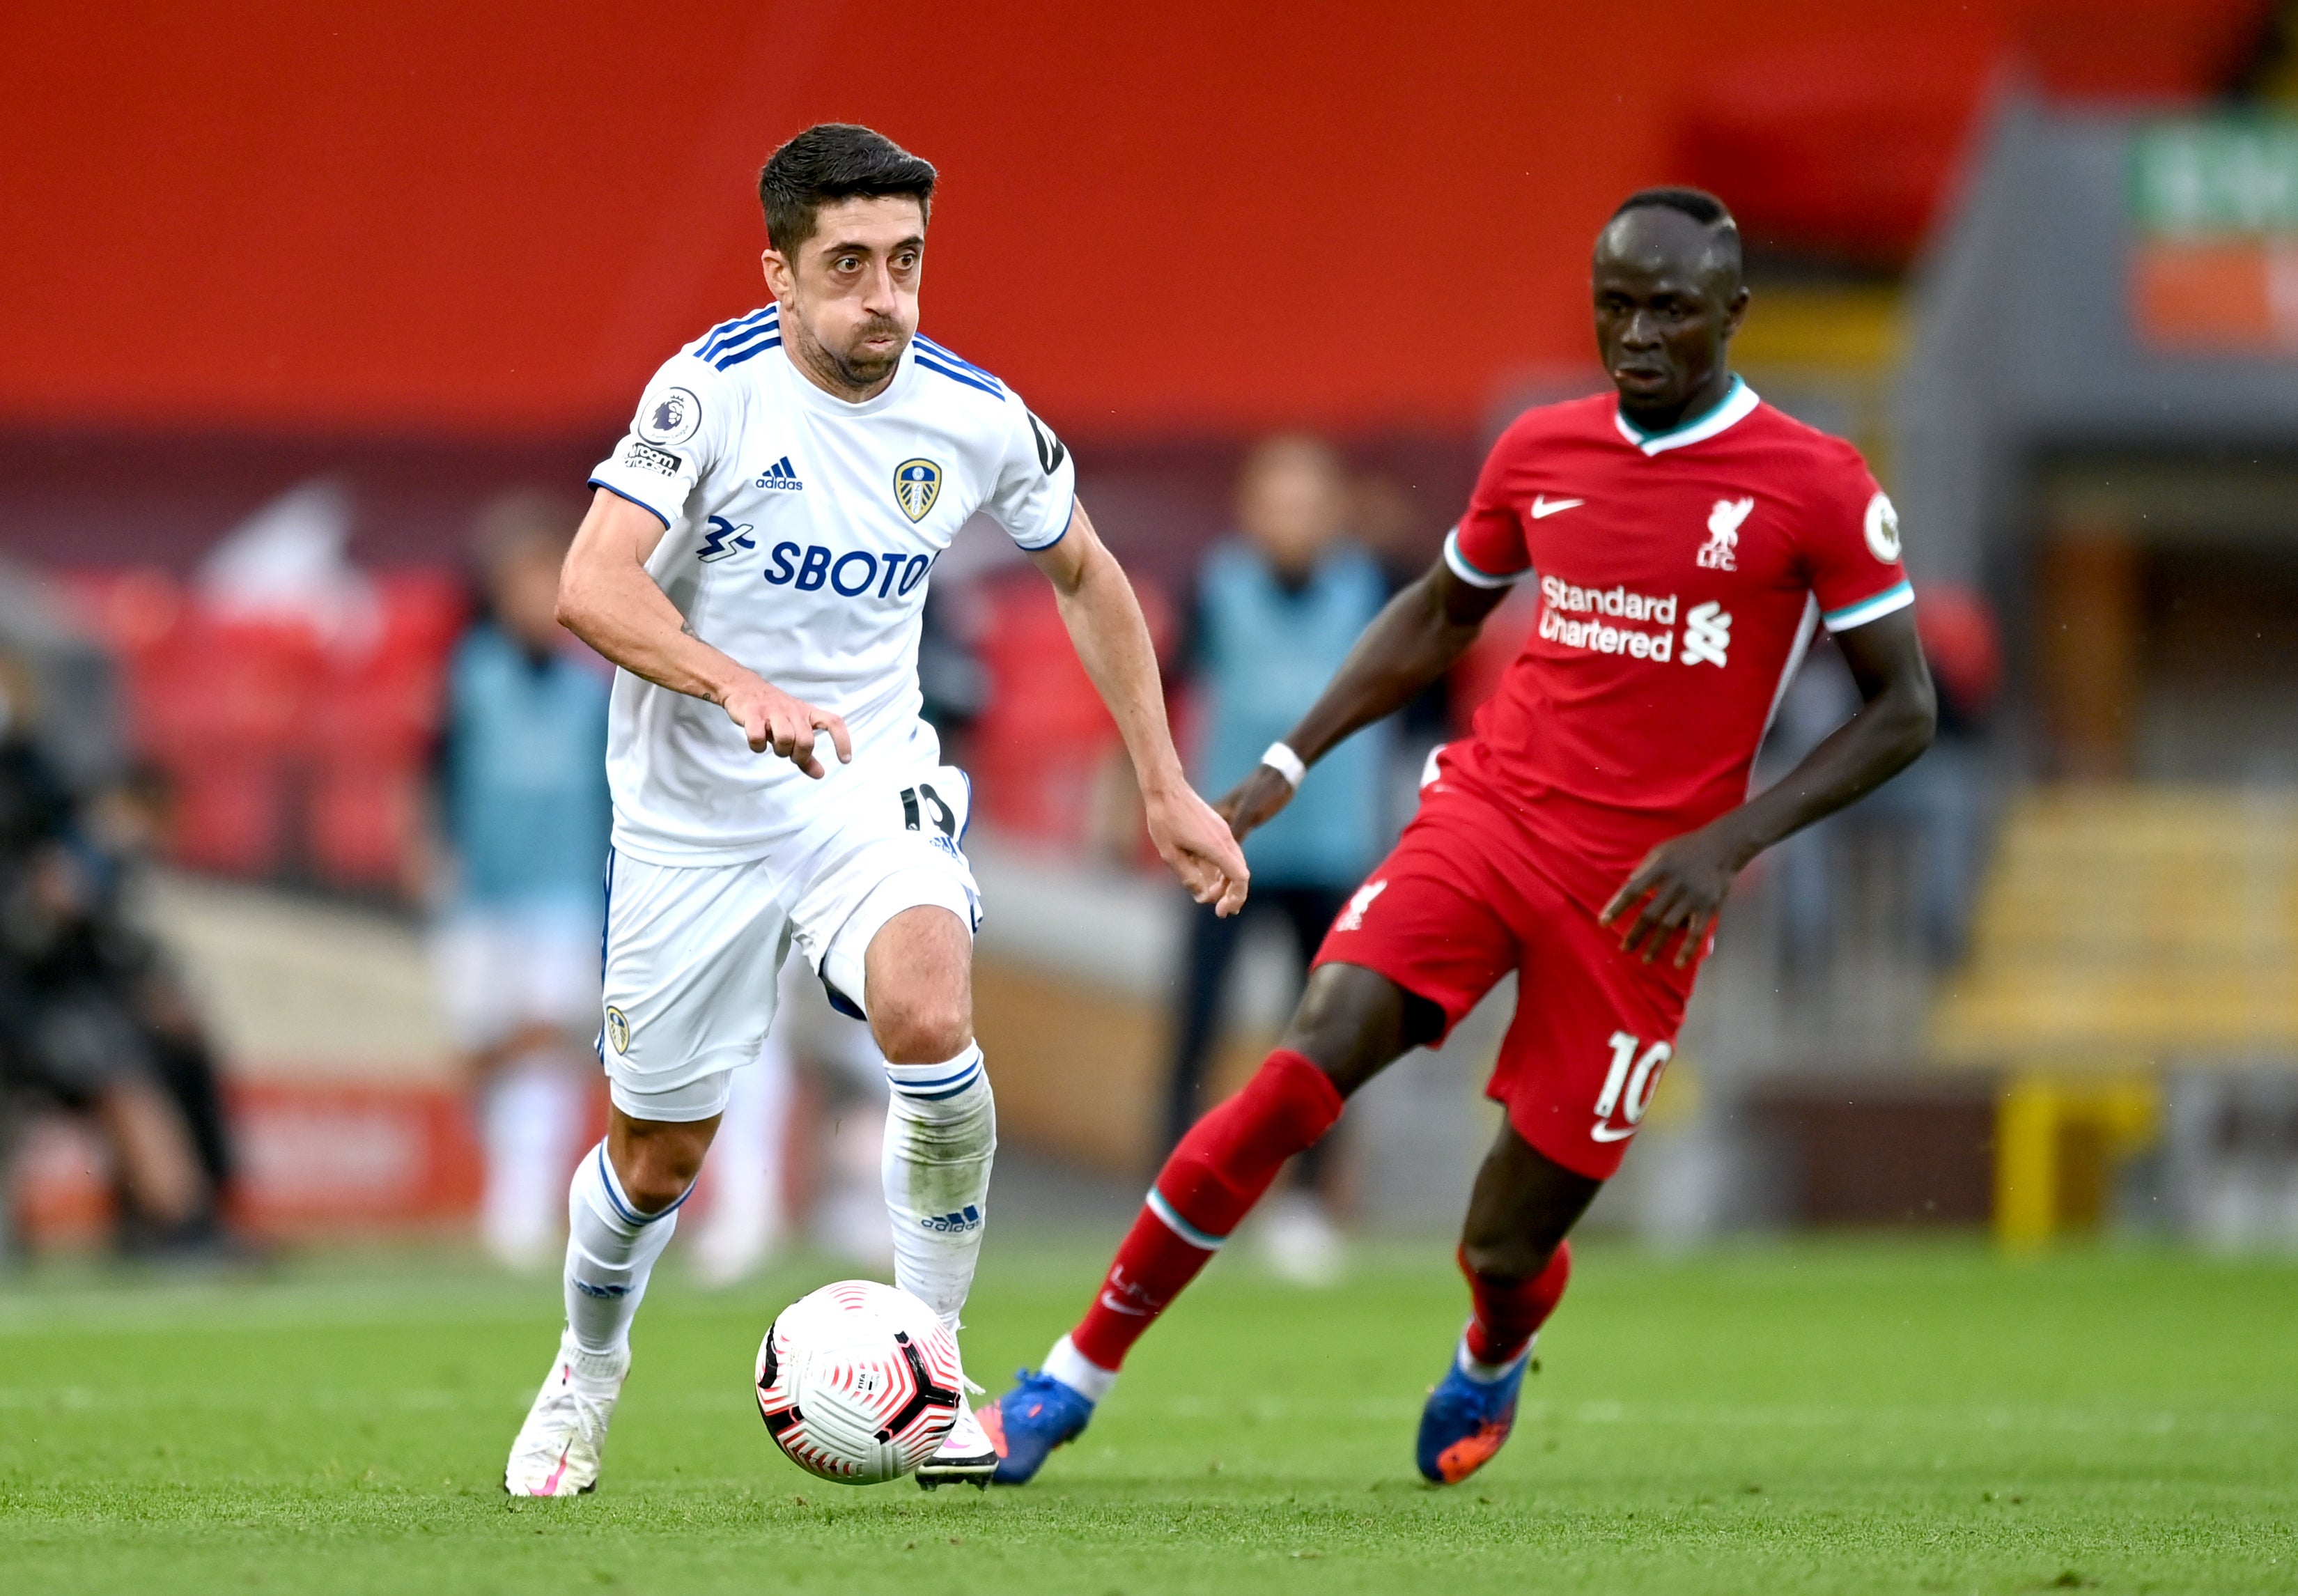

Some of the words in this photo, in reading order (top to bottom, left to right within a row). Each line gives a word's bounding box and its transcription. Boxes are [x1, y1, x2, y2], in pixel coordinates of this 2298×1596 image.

[755, 476, 803, 491] adidas
[763, 541, 940, 599] SBOTO
[1541, 574, 1678, 626] Standard
[1538, 607, 1674, 663] Chartered
[1593, 1030, 1672, 1125] 10
[857, 1373, 867, 1390] FIFA
